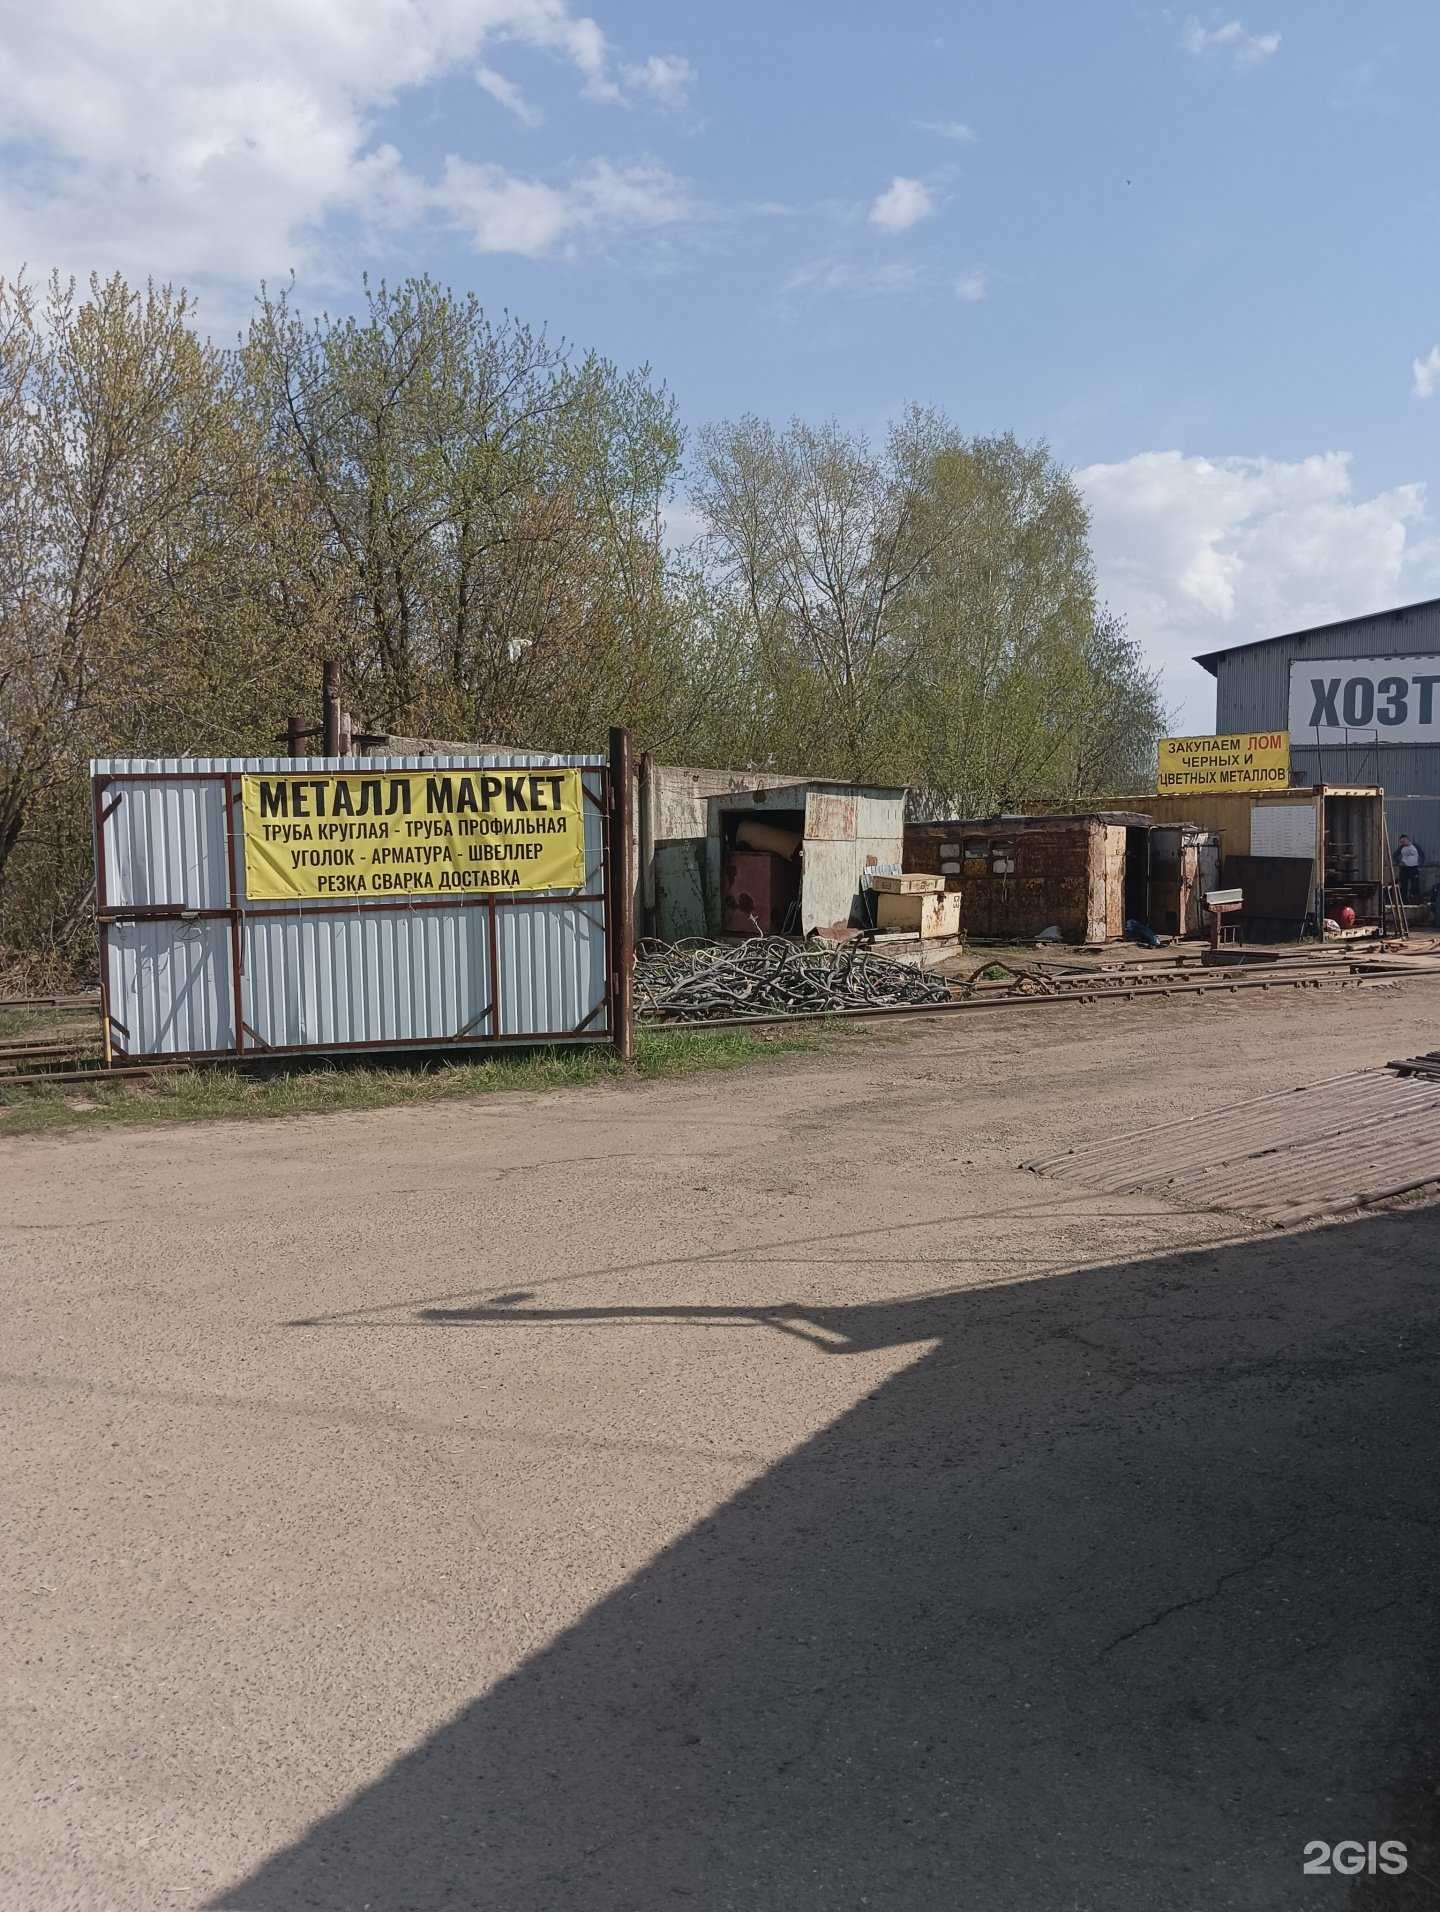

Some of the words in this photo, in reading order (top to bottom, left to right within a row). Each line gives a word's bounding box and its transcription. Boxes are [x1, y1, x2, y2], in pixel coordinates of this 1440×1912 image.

[1309, 676, 1440, 726] ХОЗТ
[1168, 739, 1240, 753] ЗАКУПАЕМ
[1248, 735, 1282, 750] ЛОМ
[1182, 756, 1240, 767] ЧЕРНЫХ
[1244, 754, 1253, 765] И
[1160, 770, 1217, 787] ЦВЕТНЫХ
[1220, 768, 1285, 783] МЕТАЛЛОВ
[259, 779, 410, 818] МЕТАЛЛ
[427, 775, 565, 814] МАРКЕТ
[263, 824, 313, 842] ТРУБА
[318, 822, 389, 840] КРУГЛАЯ
[405, 819, 453, 838] ТРУБА
[458, 816, 567, 836] ПРОФИЛЬНАЯ
[291, 849, 354, 869] УГОЛОК
[372, 846, 451, 866] АРМАТУРА
[469, 843, 543, 862] ШВЕЛЛЕР
[318, 874, 366, 892] РЕЗКА
[372, 872, 434, 890] СВАРКА
[439, 870, 520, 889] ДОСТАВКА
